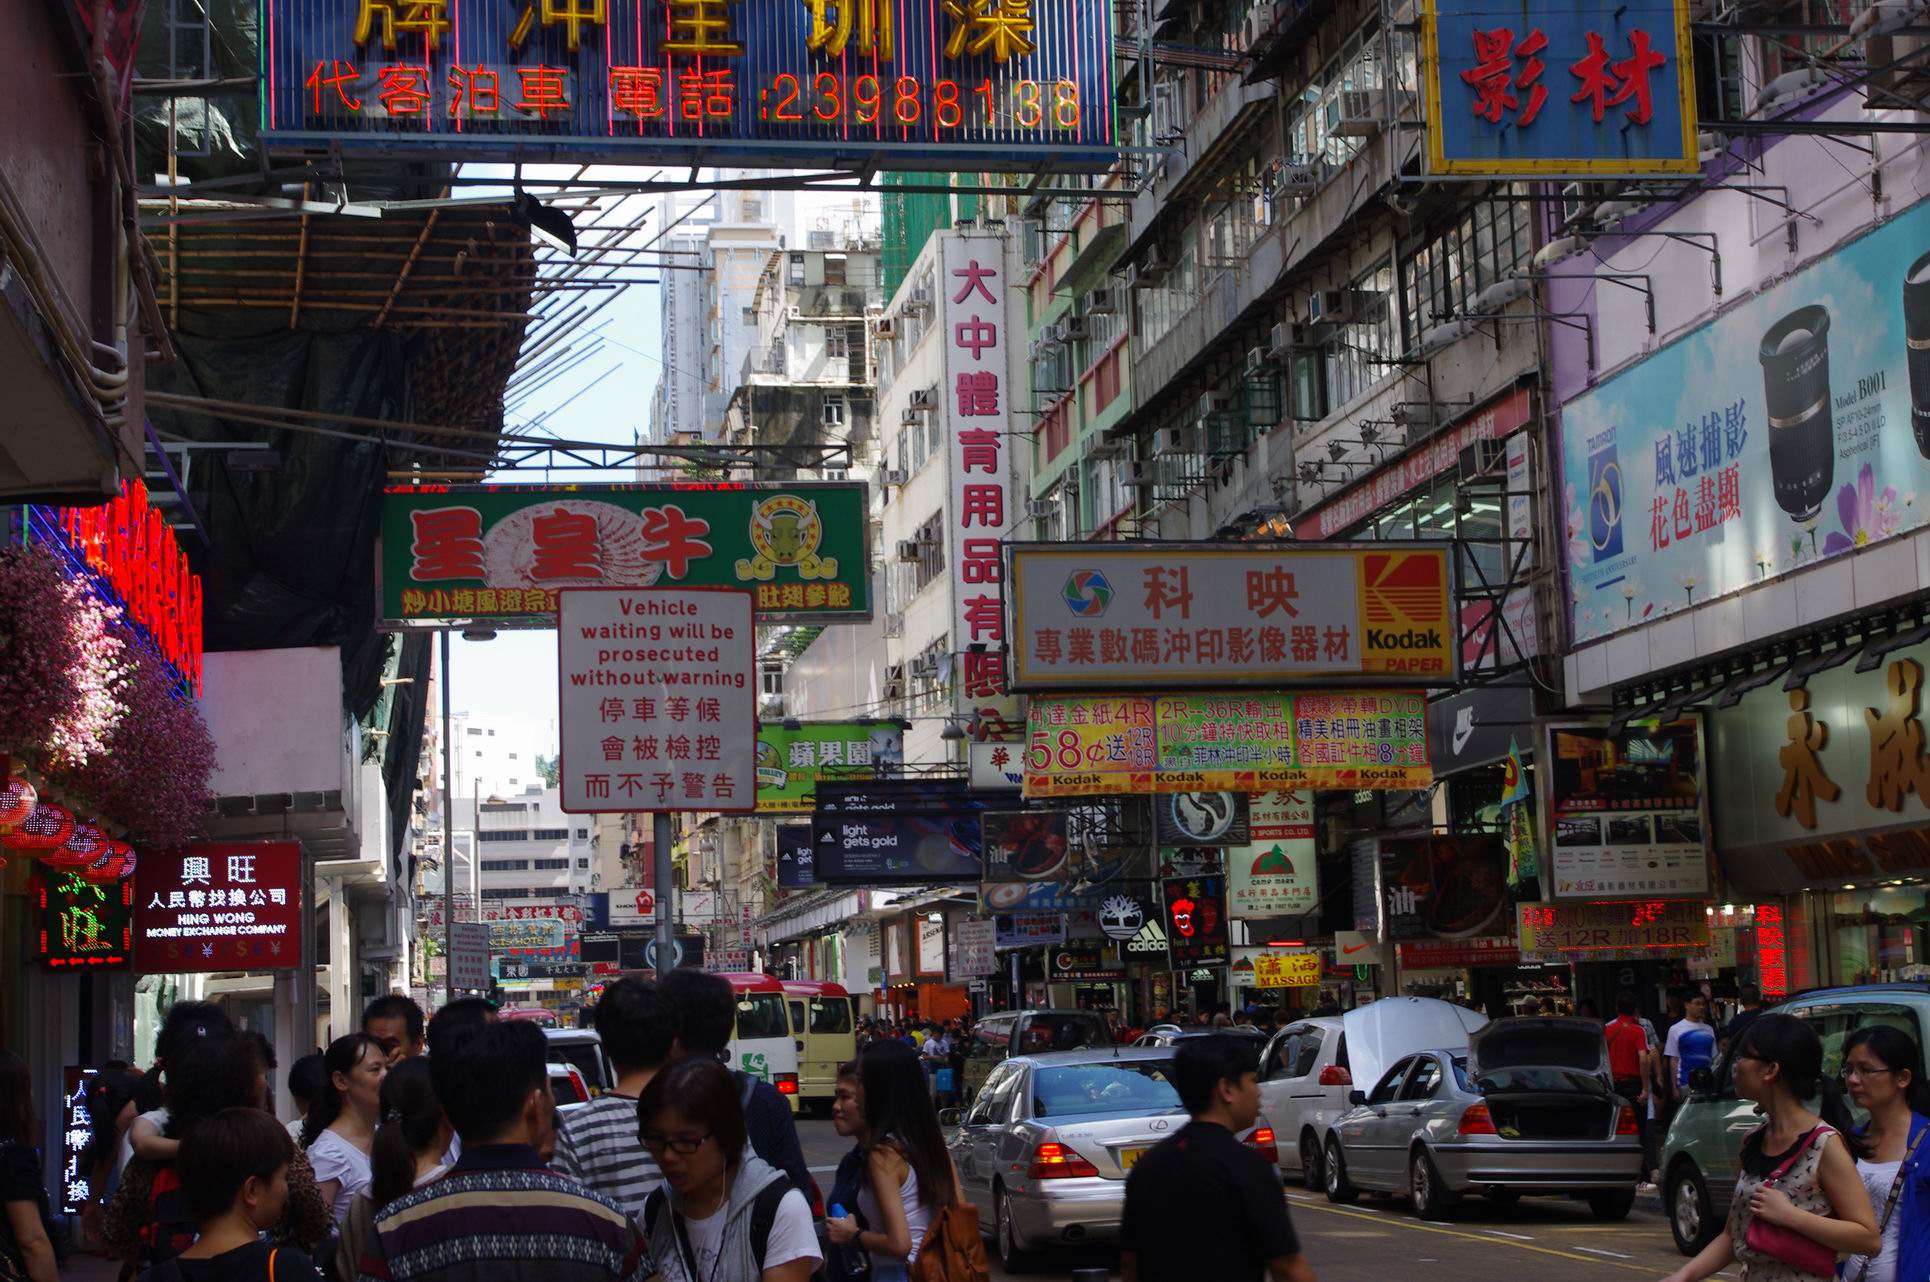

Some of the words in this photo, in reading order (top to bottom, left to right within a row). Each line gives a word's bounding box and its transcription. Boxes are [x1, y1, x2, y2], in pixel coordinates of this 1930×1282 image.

[306, 59, 571, 118] 代客泊車
[1857, 369, 1887, 400] B001
[1586, 426, 1617, 454] TAMRON
[1655, 398, 1748, 492] 風速捕影
[1648, 462, 1741, 552] 花色盡顯
[619, 598, 698, 616] Vehicle
[581, 622, 661, 640] waiting
[669, 623, 705, 639] will
[711, 624, 735, 640] be
[1366, 628, 1442, 650] Kodak
[1034, 625, 1350, 665] 專業數碼沖印影像器材
[598, 646, 719, 665] prosecuted
[1385, 657, 1443, 672] PAPER
[570, 669, 655, 685] without
[662, 670, 745, 688] warning
[599, 696, 721, 723] 停車等候
[600, 734, 721, 761] 會被檢控
[1052, 773, 1102, 786] Kodak
[1155, 770, 1206, 783] Kodak
[1258, 768, 1309, 781] Kodak
[1360, 768, 1406, 780] Kodak
[584, 771, 735, 799] 而不予警告
[842, 824, 869, 838] light
[842, 837, 871, 850] gets
[871, 835, 898, 850] gold
[147, 887, 286, 909] 人民幣找換公司
[177, 912, 210, 925] HING
[212, 912, 256, 924] WONG
[146, 927, 183, 938] MONEY
[182, 926, 238, 936] EXCHANGE
[237, 924, 287, 936] COMPANY
[1260, 974, 1320, 987] MASSAGE
